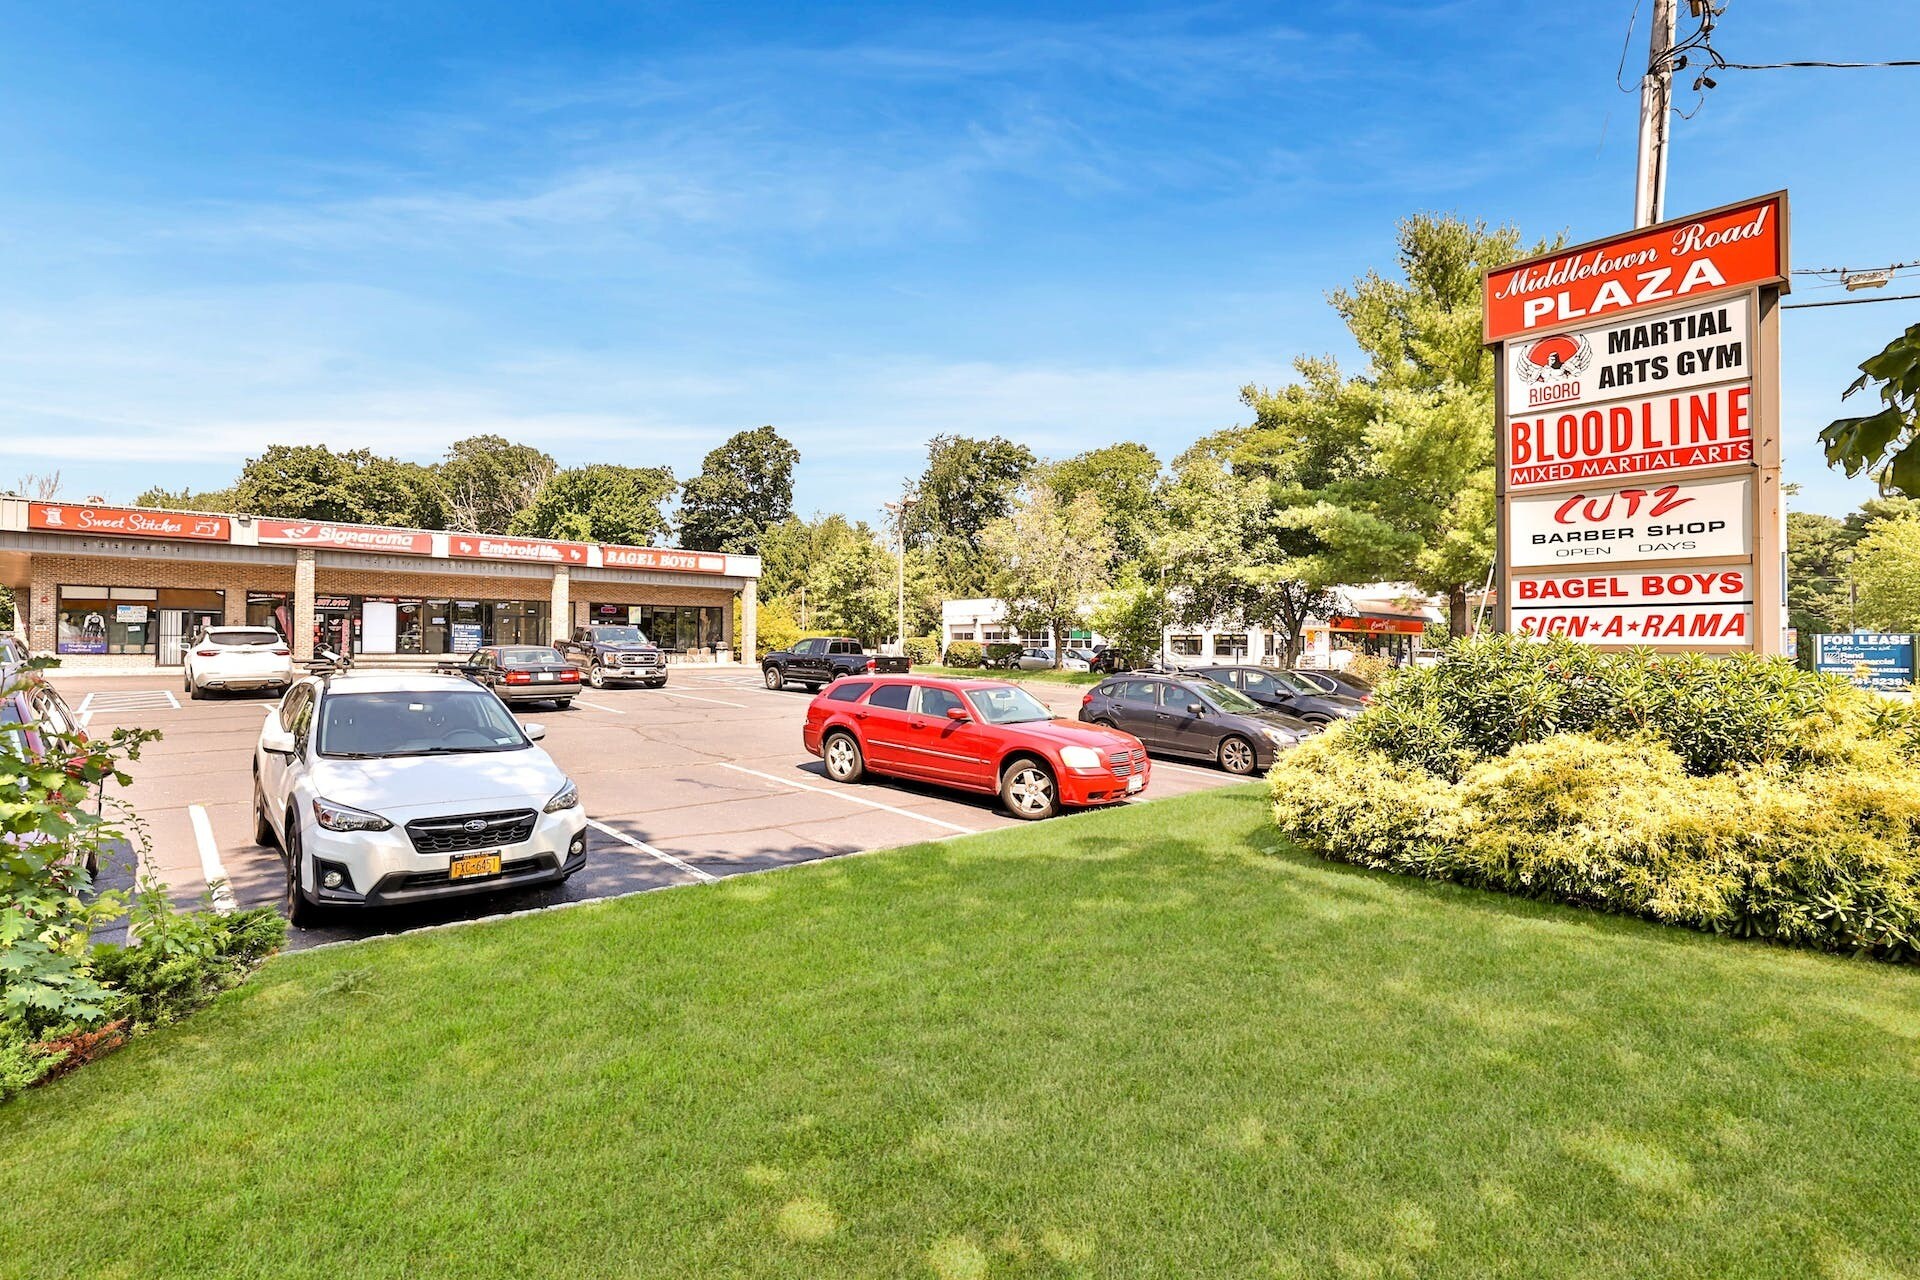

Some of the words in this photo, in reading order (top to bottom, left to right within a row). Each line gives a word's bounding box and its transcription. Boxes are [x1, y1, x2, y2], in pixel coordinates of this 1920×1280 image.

[1495, 246, 1658, 299] Middletown
[1671, 206, 1770, 256] Road
[1523, 257, 1726, 328] PLAZA
[1608, 308, 1732, 354] MARTIAL
[1598, 358, 1669, 390] ARTS
[1677, 342, 1742, 376] GYM
[1529, 381, 1580, 403] RIGORO
[1511, 386, 1751, 465] BLOODLINE
[1511, 464, 1575, 485] MIXED
[1581, 450, 1680, 477] MARTIAL
[1690, 442, 1753, 463] ARTS
[1554, 485, 1696, 524] CUTZ
[77, 509, 125, 529] Sweet
[127, 513, 183, 533] Stitches
[1532, 528, 1634, 545] BARBER
[1647, 520, 1726, 537] SHOP
[318, 527, 413, 546] Signarama
[1556, 546, 1611, 558] OPEN
[1638, 541, 1697, 553] DAYS
[606, 551, 656, 566] BAGEL
[660, 554, 695, 568] BOYS
[1519, 577, 1629, 600] BAGEL
[1642, 572, 1745, 596] BOYS
[1823, 635, 1853, 645] FOR
[1859, 635, 1910, 645] LEASE
